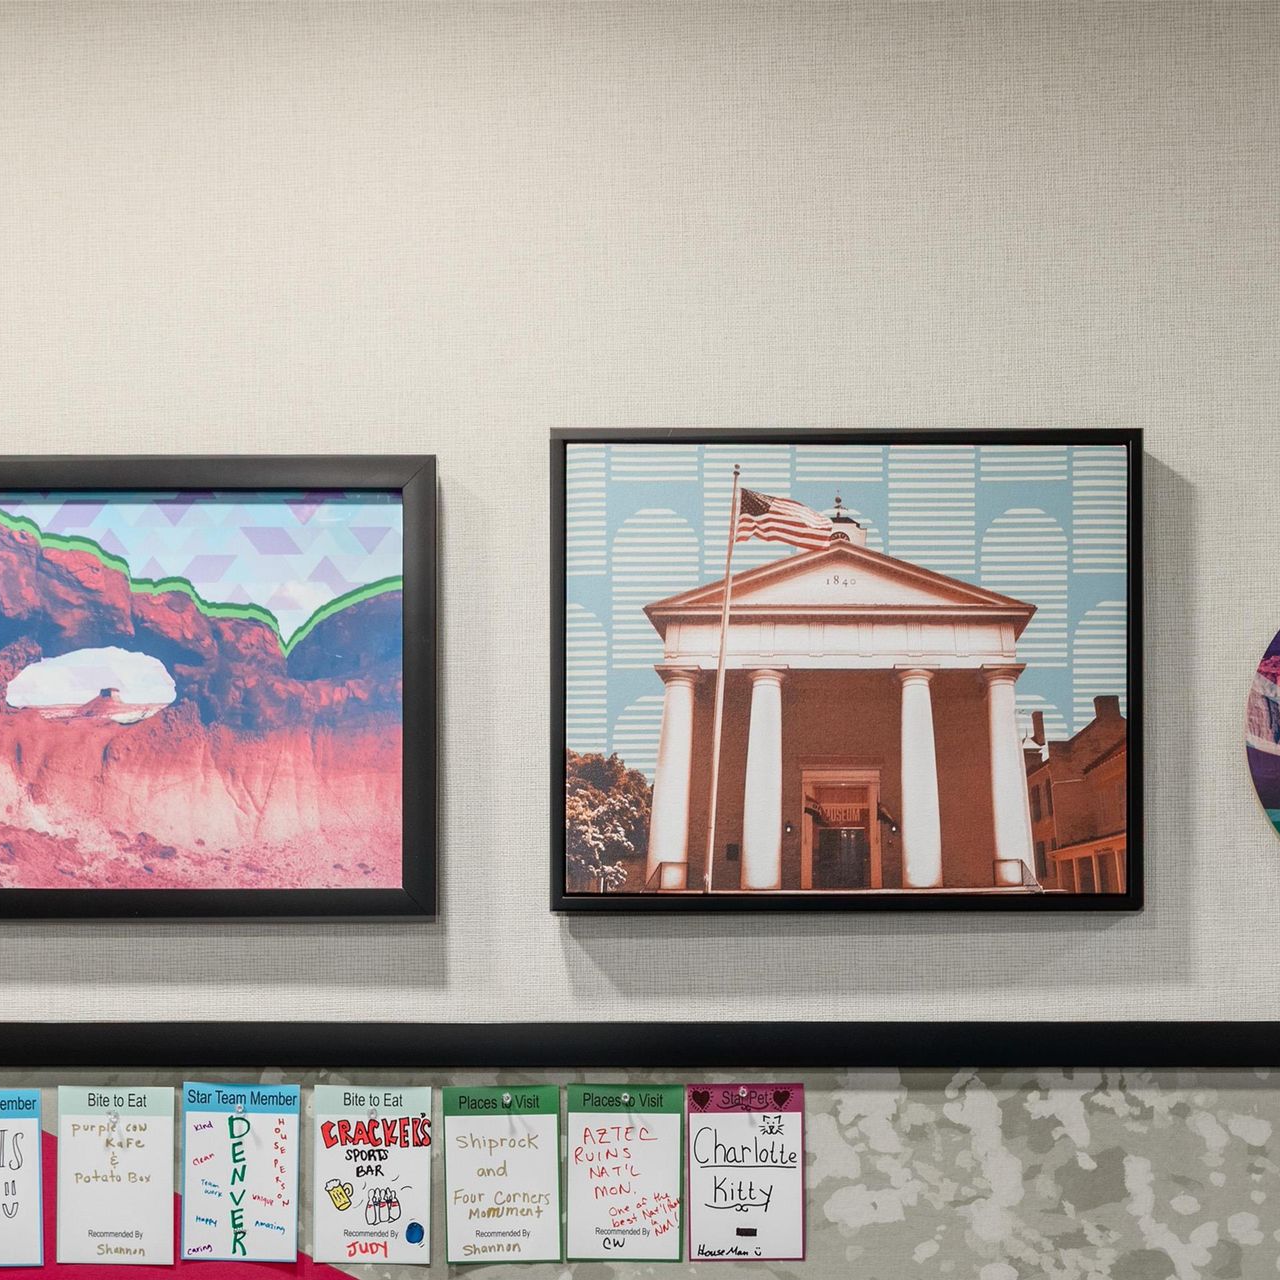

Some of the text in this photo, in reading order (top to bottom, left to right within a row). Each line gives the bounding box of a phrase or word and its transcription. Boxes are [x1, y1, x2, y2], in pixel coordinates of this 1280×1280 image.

[826, 575, 857, 588] 1840
[88, 1093, 147, 1108] Bite to Eat
[188, 1089, 298, 1106] Star Team Member
[343, 1092, 403, 1107] Bite to Eat
[459, 1095, 540, 1110] Places Visit
[583, 1092, 663, 1107] Places Visit
[749, 1091, 769, 1105] Pet
[583, 1127, 658, 1144] AZTEC
[455, 1133, 539, 1156] Shiprock
[693, 1126, 798, 1165] Charlotte
[345, 1149, 389, 1162] SPORTS
[574, 1146, 631, 1164] RUINS
[356, 1165, 384, 1177] BAR
[477, 1160, 508, 1177] and
[128, 1171, 151, 1184] Box
[227, 1115, 251, 1256] DENVER
[454, 1189, 551, 1206] Four Corners
[713, 1175, 773, 1213] Kitty
[609, 1206, 630, 1217] One
[612, 1213, 637, 1228] best
[88, 1229, 144, 1240] Recommended By
[343, 1229, 388, 1238] Recommended
[476, 1230, 520, 1238] Recommended
[595, 1227, 640, 1236] Recommended
[97, 1244, 145, 1257] Shannon
[347, 1241, 388, 1258] JUDY
[463, 1242, 522, 1256] Shannon
[602, 1237, 625, 1250] CW
